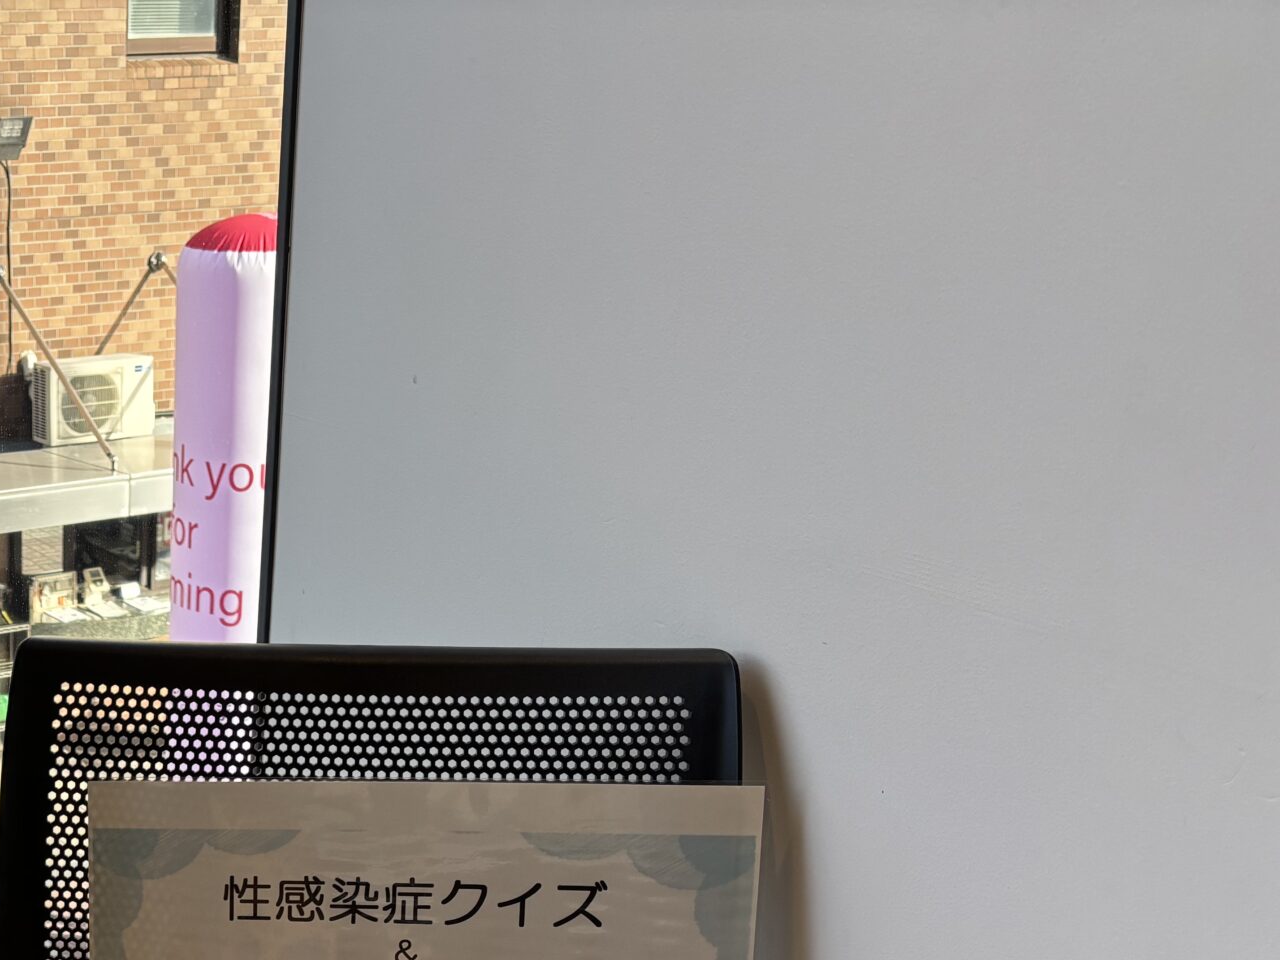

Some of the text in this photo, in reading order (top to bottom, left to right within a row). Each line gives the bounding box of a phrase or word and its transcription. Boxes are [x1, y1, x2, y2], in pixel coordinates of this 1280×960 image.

[223, 875, 608, 928] 性感染症クイズ
